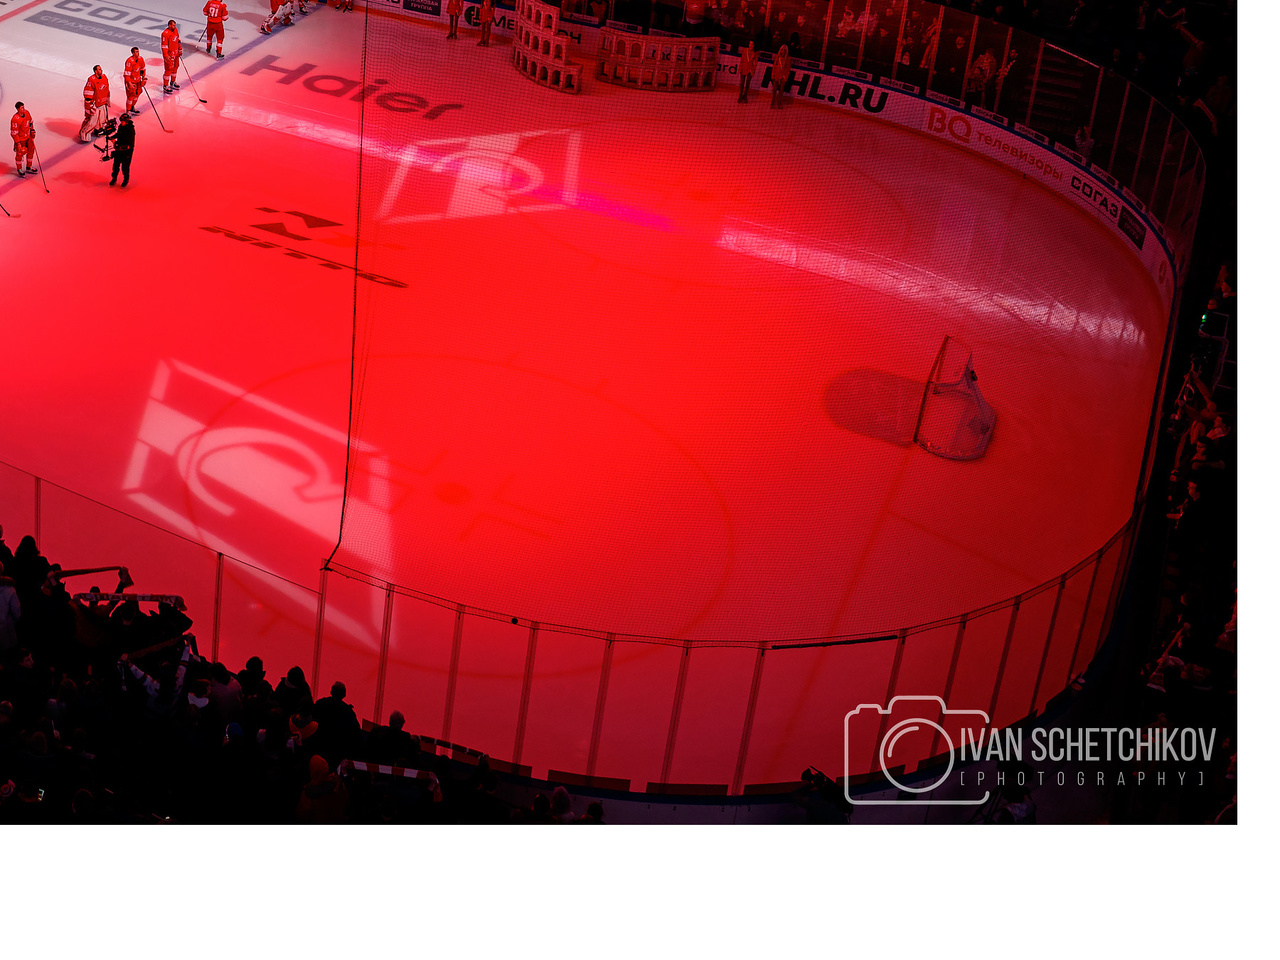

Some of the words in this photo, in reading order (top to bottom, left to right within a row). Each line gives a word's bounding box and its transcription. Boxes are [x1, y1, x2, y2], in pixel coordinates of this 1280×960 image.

[208, 7, 219, 18] 91
[409, 1, 435, 12] ГРУППА
[41, 15, 126, 39] СТРАХОВАЯ
[239, 53, 465, 121] Haier
[927, 106, 972, 143] BQ
[977, 131, 1064, 182] телевизоры
[1070, 175, 1121, 219] СОГАЗ
